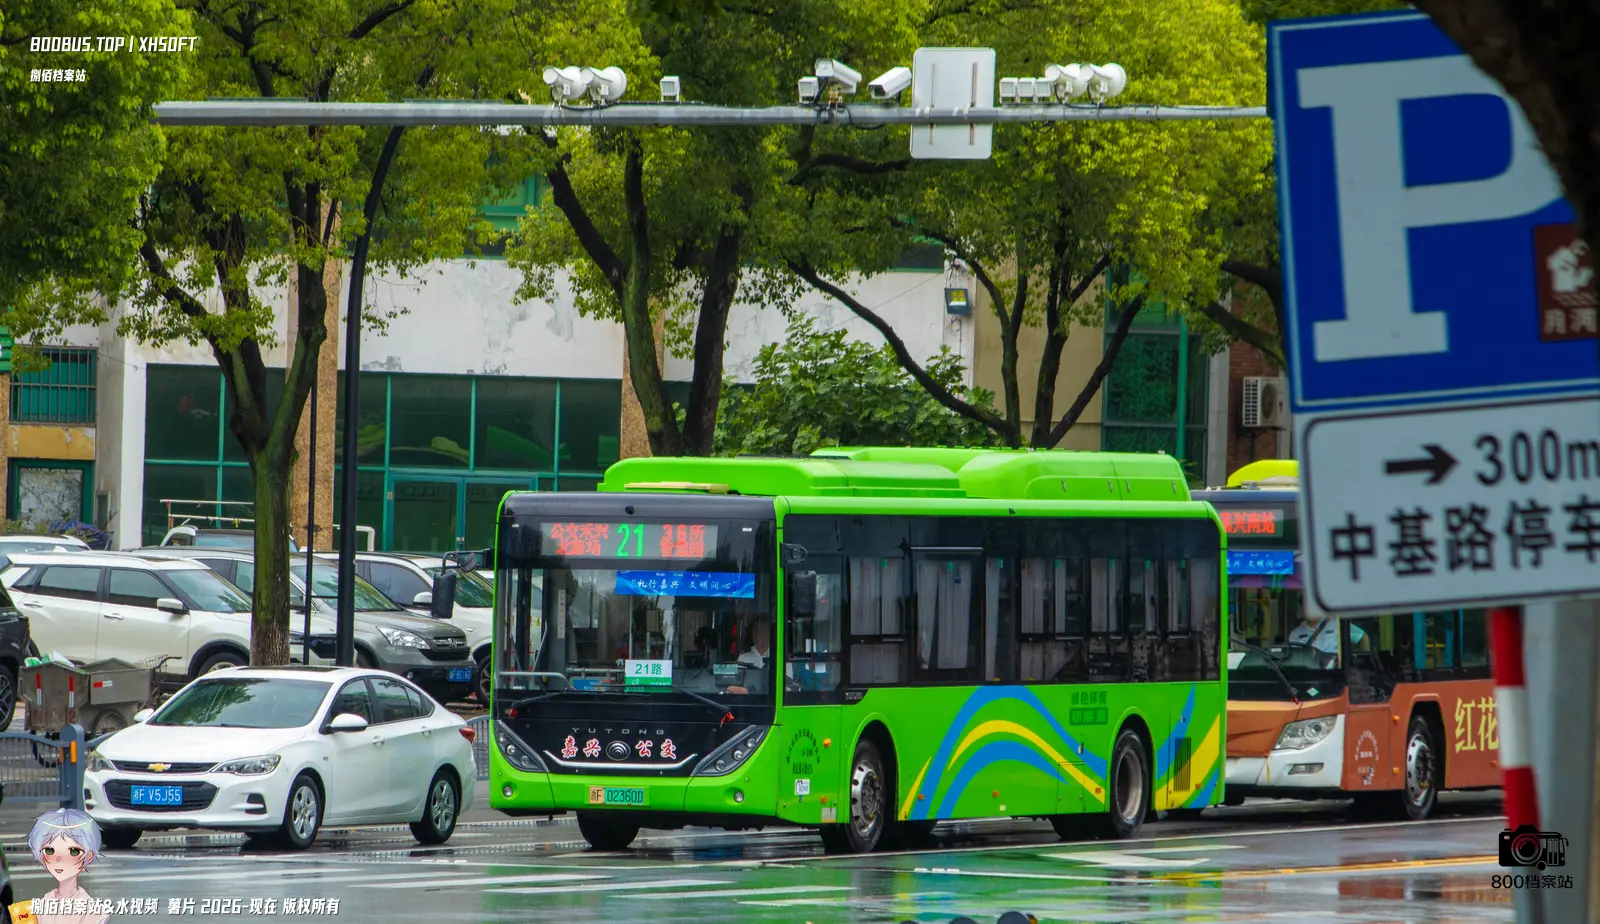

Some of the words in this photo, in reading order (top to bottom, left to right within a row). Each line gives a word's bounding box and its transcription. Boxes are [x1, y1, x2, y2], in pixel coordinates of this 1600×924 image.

[1297, 54, 1565, 363] P
[1474, 428, 1600, 487] 300m
[615, 523, 645, 557] 21
[1328, 494, 1600, 582] 中基路停车
[635, 663, 662, 675] 21路
[572, 727, 665, 735] YUTONG
[1454, 696, 1500, 754] 红花
[561, 735, 602, 759] 嘉兴
[635, 738, 677, 760] 公交
[148, 788, 181, 802] V5J55
[606, 789, 644, 804] 02360D
